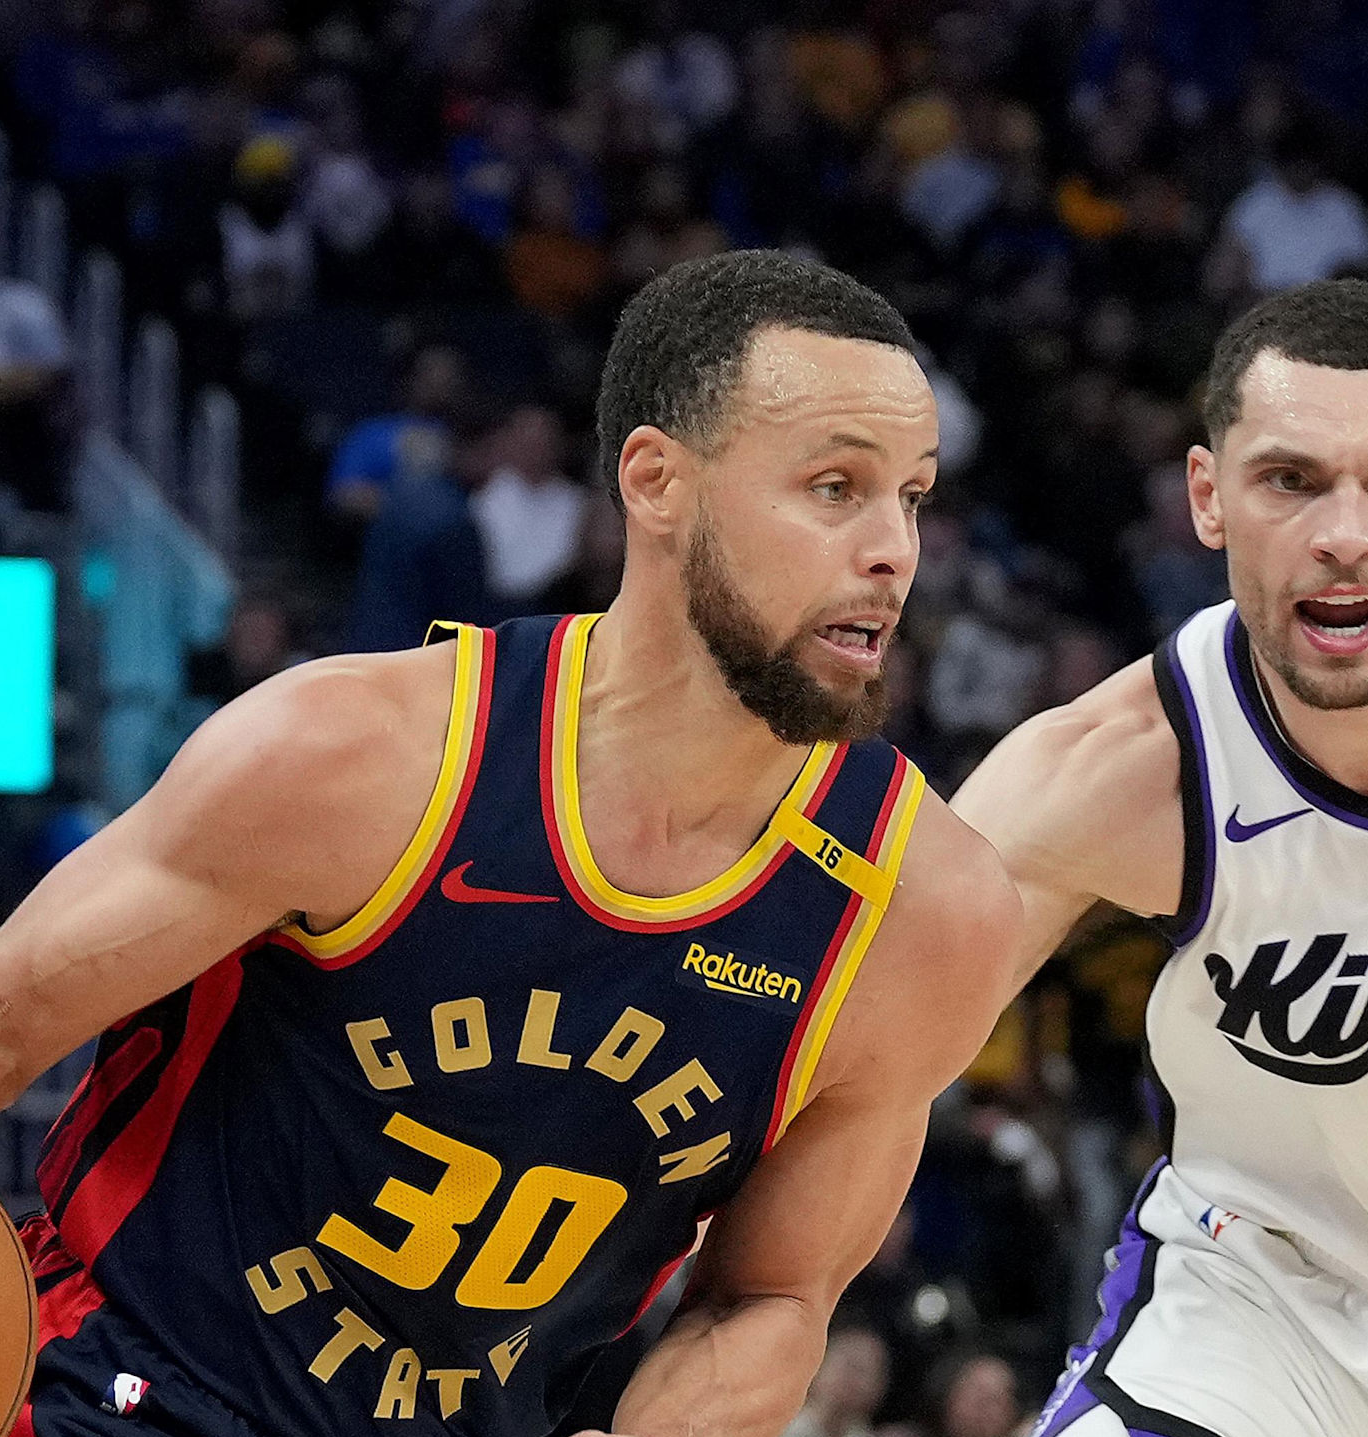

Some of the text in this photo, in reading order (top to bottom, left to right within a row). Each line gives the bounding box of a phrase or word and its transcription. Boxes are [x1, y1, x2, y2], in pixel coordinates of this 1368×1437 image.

[815, 838, 843, 870] 16
[682, 942, 802, 1004] Rakuten
[346, 989, 731, 1184] GOLDEN
[316, 1112, 629, 1310] 30
[245, 1246, 532, 1420] STATE
